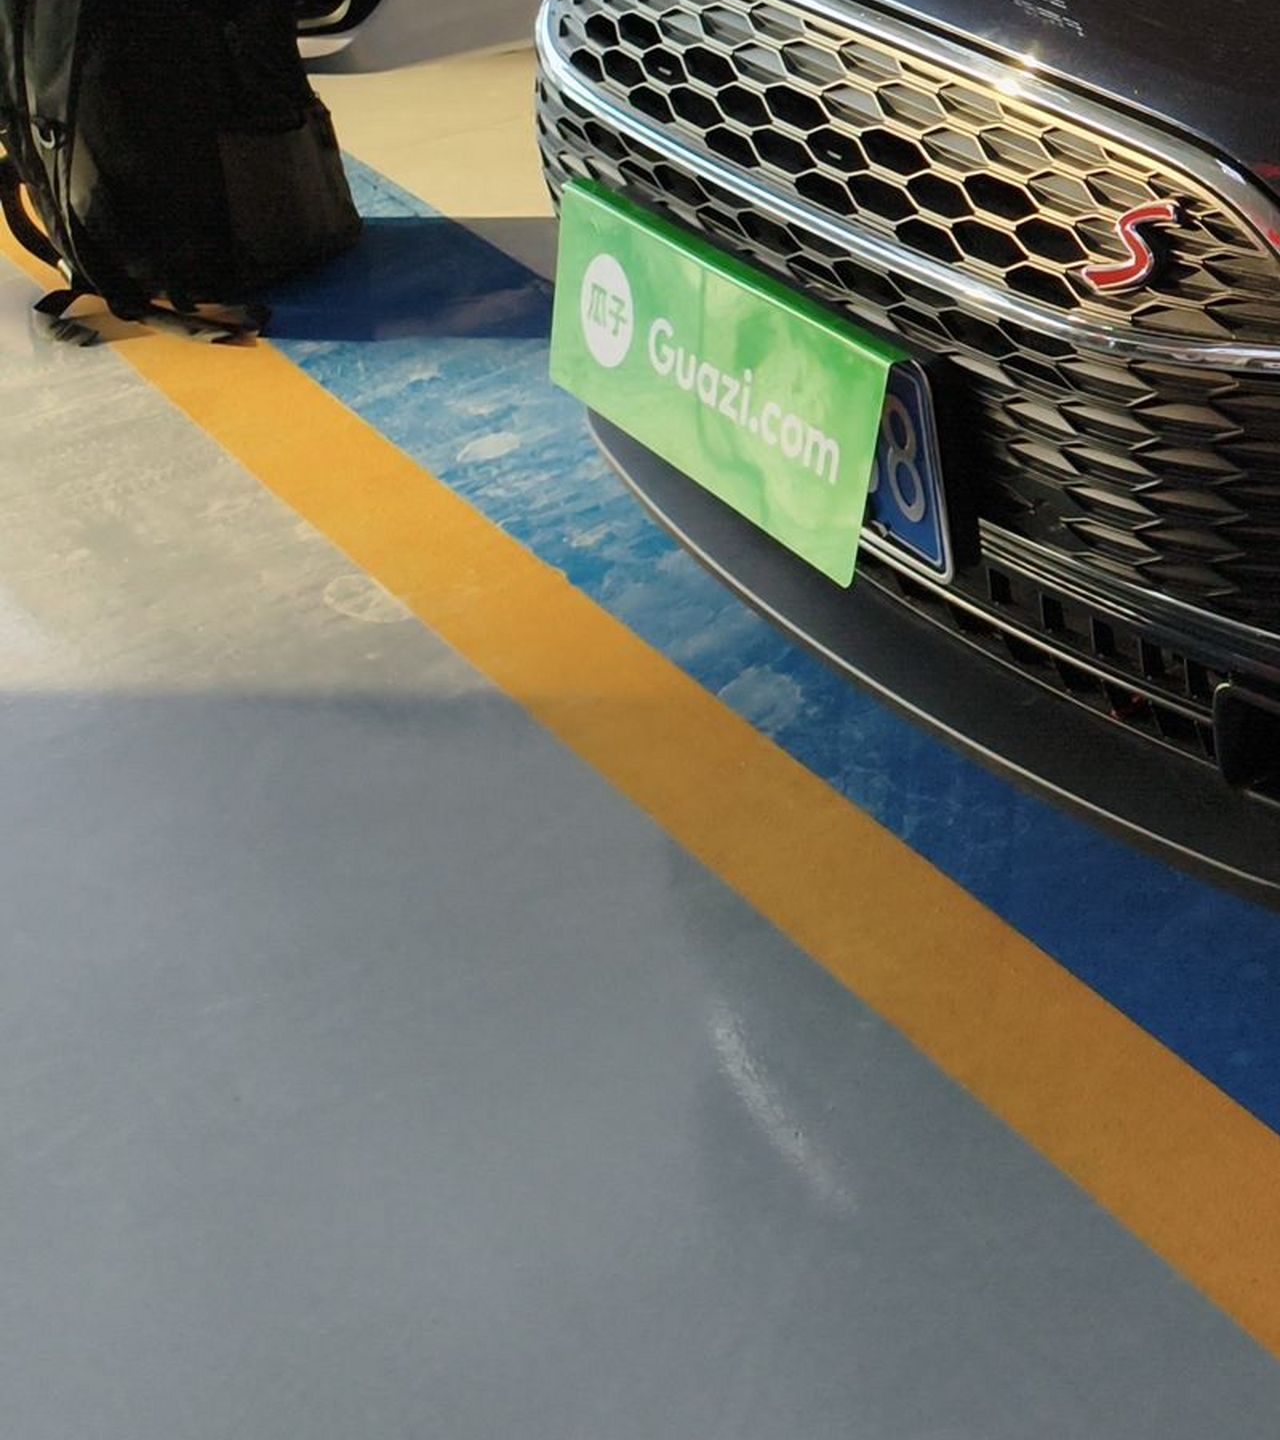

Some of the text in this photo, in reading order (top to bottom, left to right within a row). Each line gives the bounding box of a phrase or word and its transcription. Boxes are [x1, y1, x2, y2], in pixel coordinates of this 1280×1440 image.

[1081, 198, 1180, 295] S
[648, 317, 841, 487] Guazi.com
[868, 393, 927, 524] 8
